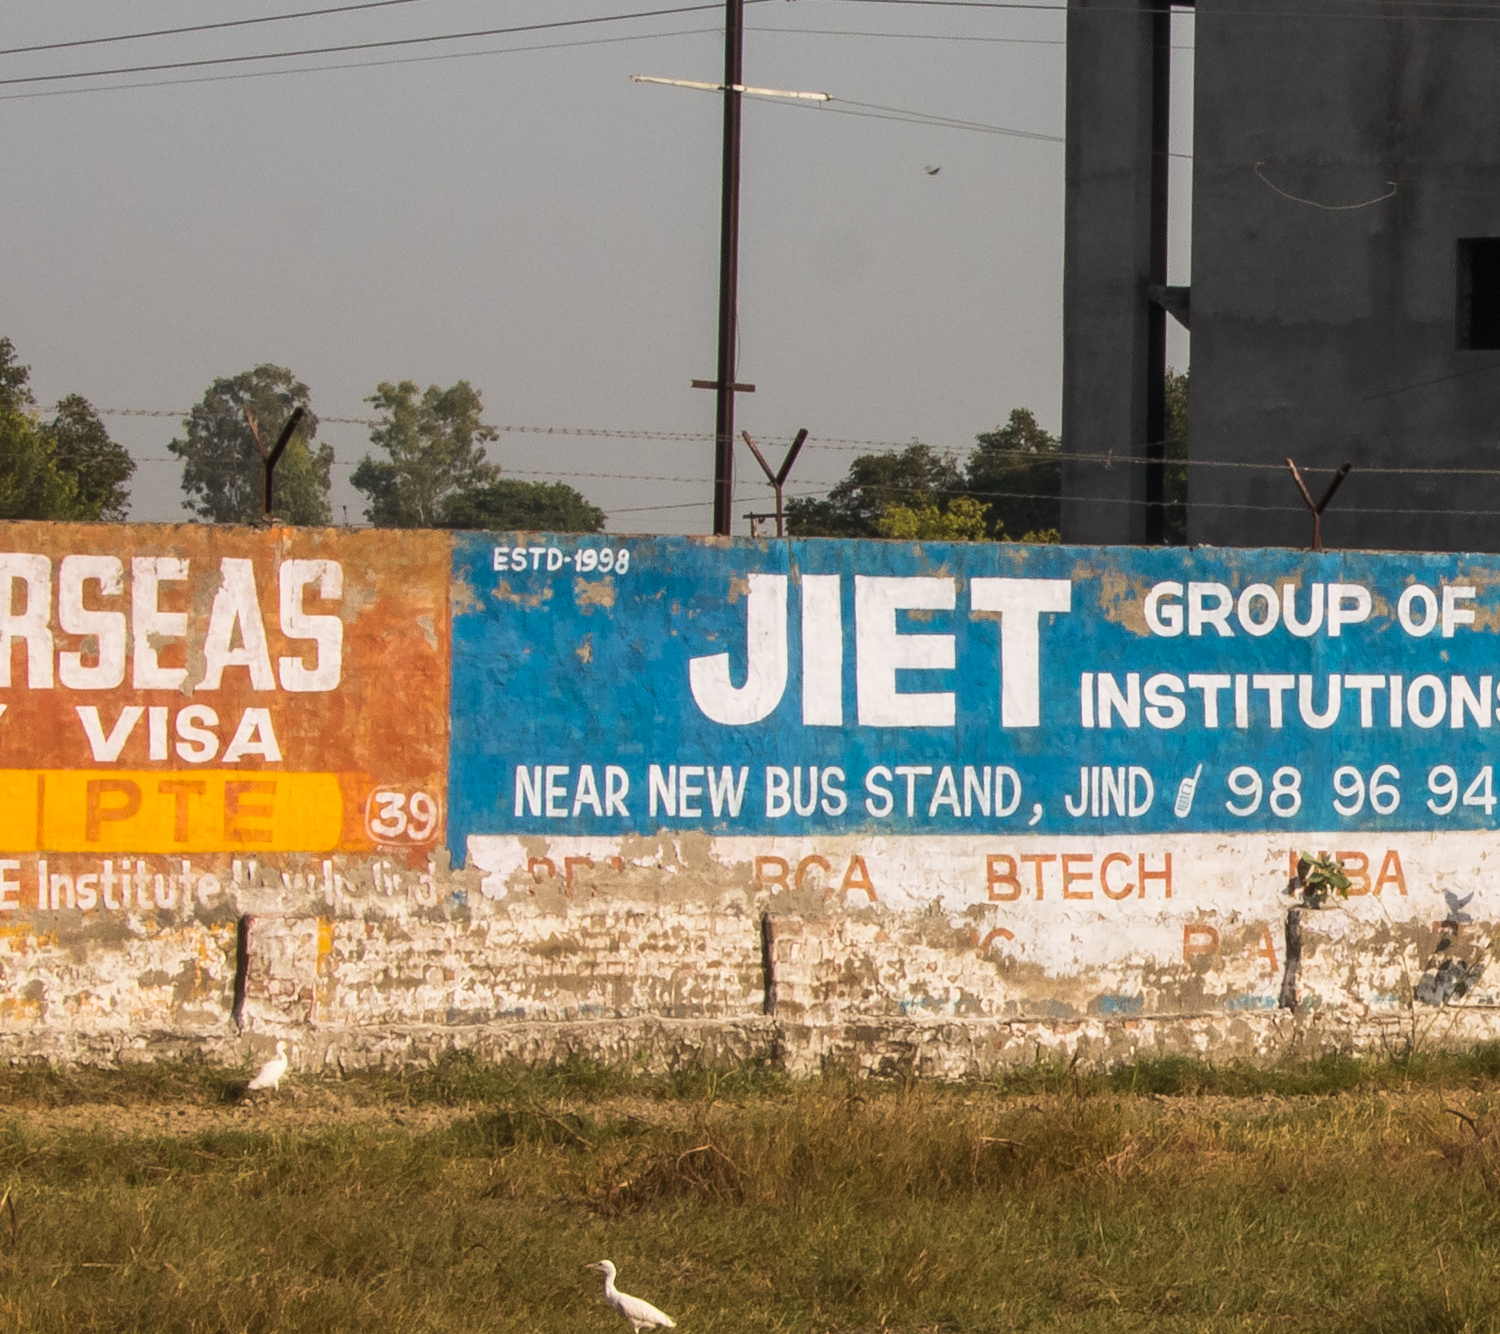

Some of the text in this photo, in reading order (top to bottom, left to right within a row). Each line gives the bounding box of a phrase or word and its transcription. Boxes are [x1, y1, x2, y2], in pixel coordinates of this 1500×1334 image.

[493, 547, 631, 575] ESTD-1998
[1143, 581, 1477, 638] GROUP OF
[689, 573, 1072, 728] JIET
[75, 704, 284, 763] VISA
[85, 778, 278, 844] PTE
[370, 791, 438, 841] 39
[513, 764, 631, 818] NEAR
[648, 765, 749, 818] NEW
[765, 766, 849, 818] BUS
[1064, 765, 1155, 818] JIND
[1225, 765, 1303, 818] 98
[1331, 763, 1401, 817] 96
[1426, 764, 1497, 817] 94
[38, 859, 222, 912] Institute
[985, 852, 1173, 902] BTECH
